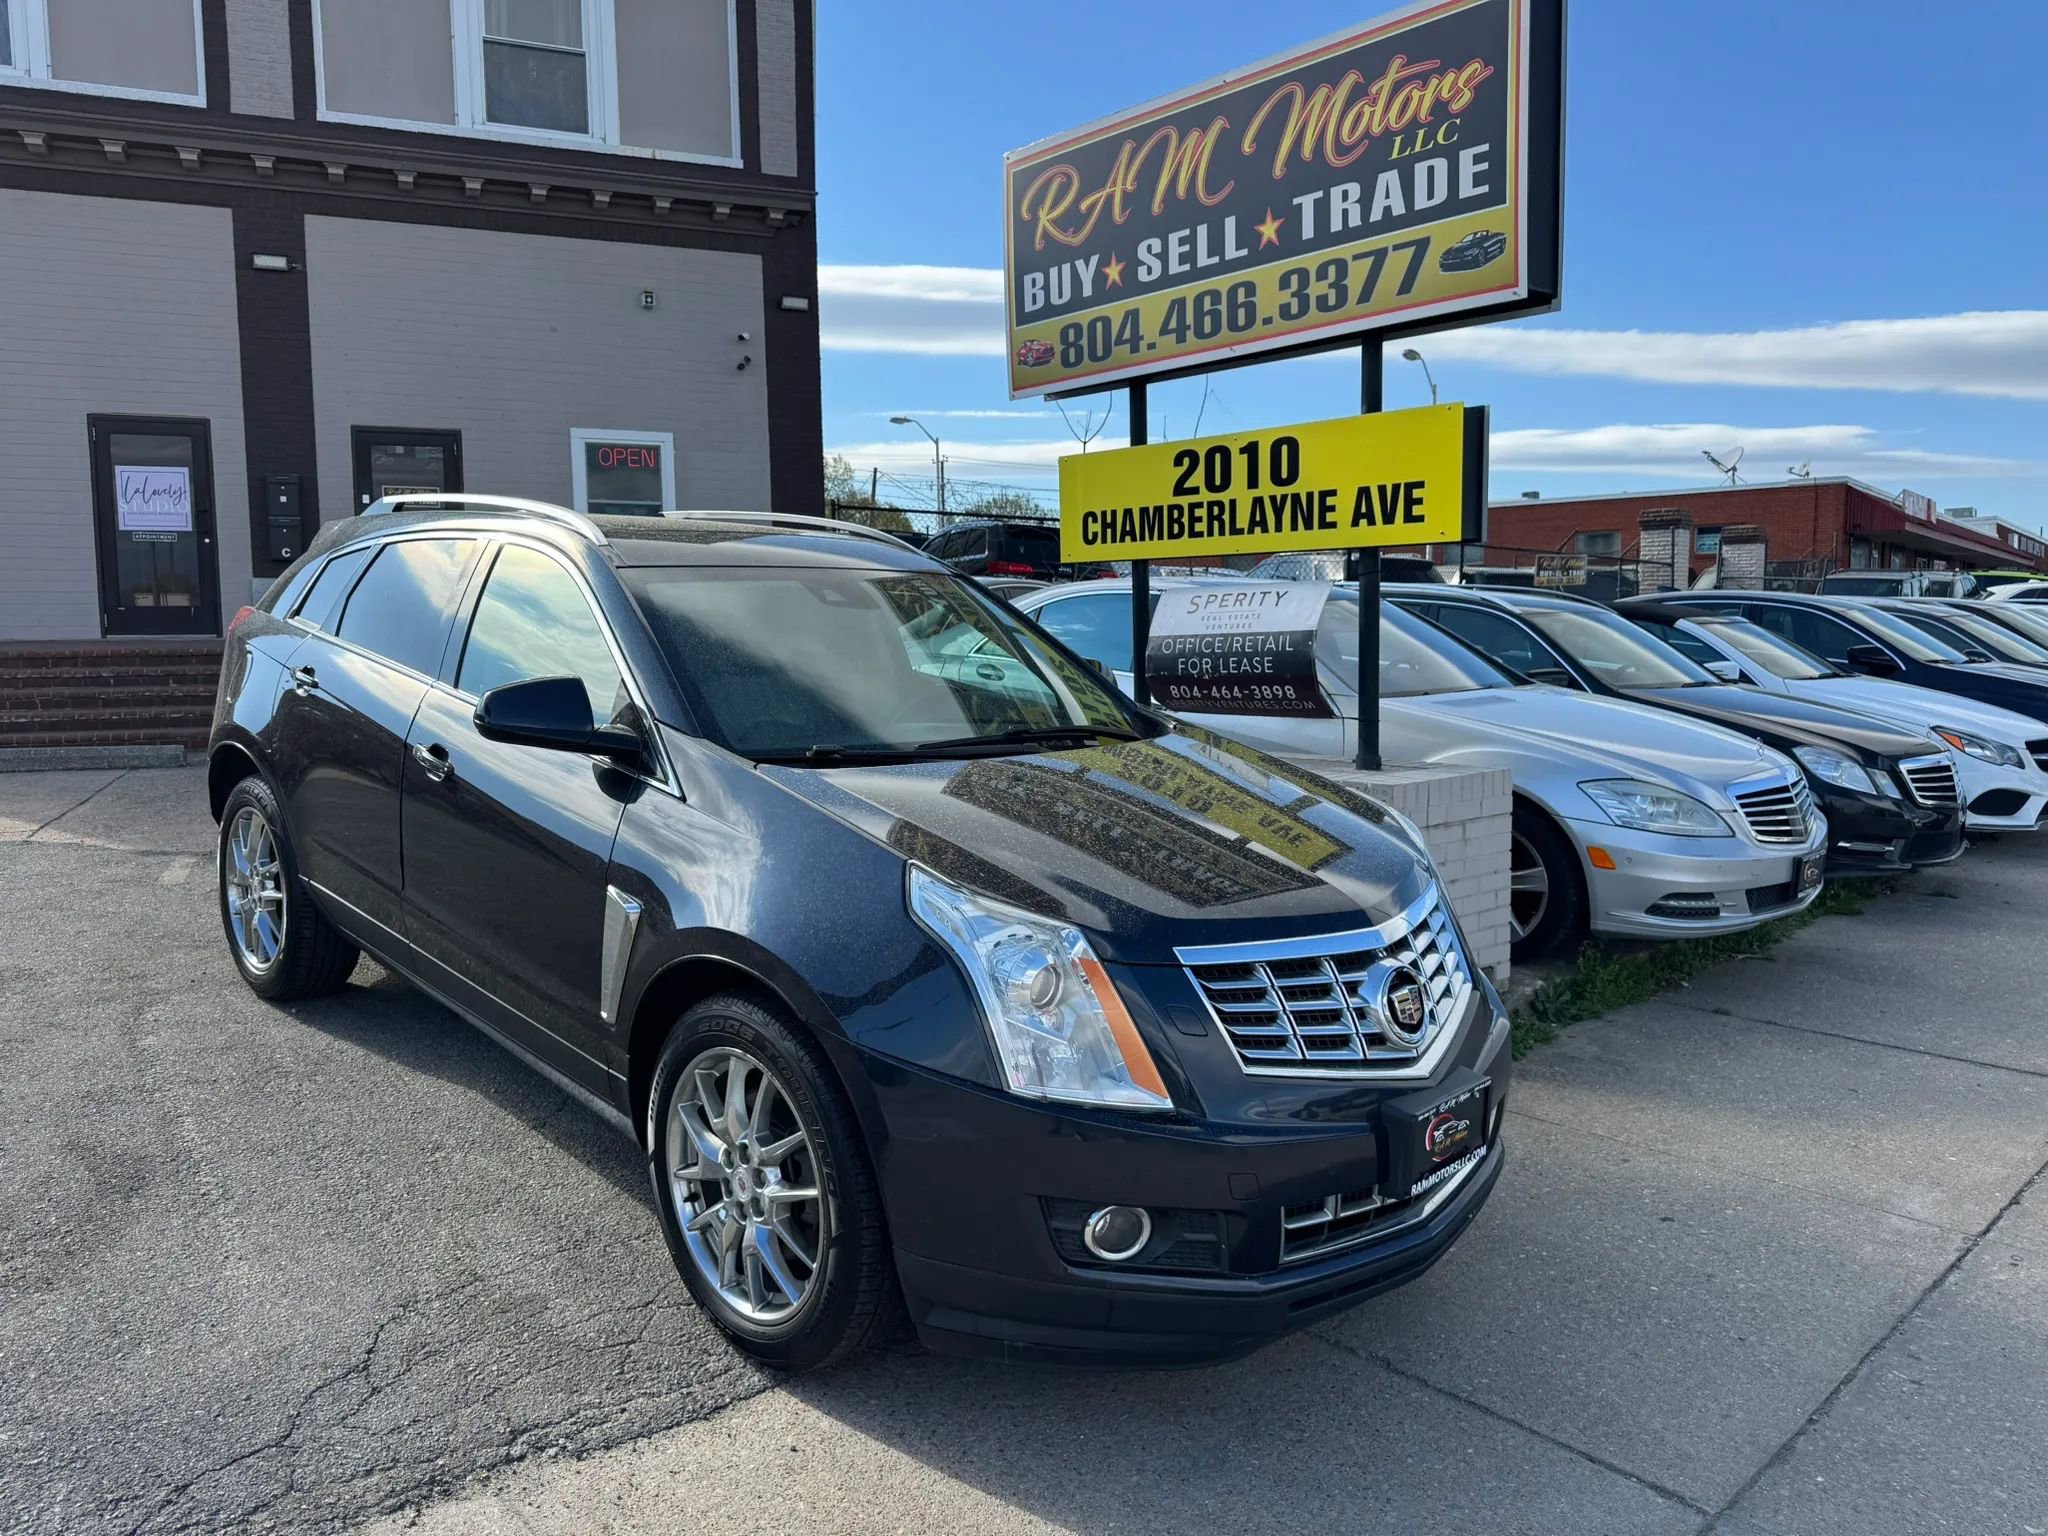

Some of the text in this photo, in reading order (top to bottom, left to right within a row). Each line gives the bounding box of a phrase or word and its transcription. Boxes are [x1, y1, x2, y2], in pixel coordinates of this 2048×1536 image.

[1388, 118, 1461, 160] LLC
[1020, 54, 1494, 251] RAM Motors
[1023, 143, 1490, 313] BUY SELL TRADE
[1059, 236, 1432, 370] 804.466.3377
[598, 447, 655, 469] OPEN
[1172, 435, 1300, 497] 2010
[119, 499, 189, 513] STUDIO
[1081, 480, 1426, 546] CHAMBERLAYNE AVE
[281, 547, 291, 557] C
[1187, 590, 1289, 615] SPERITY
[1205, 622, 1253, 631] VENTURES
[1228, 612, 1262, 621] ESTATE
[1162, 635, 1294, 654] OFFICE/RETAIL
[1178, 657, 1273, 675] FOR LEASE
[1170, 685, 1296, 699] 804-464-3898
[1411, 1145, 1487, 1197] RAMMOTORSLLC.COM
